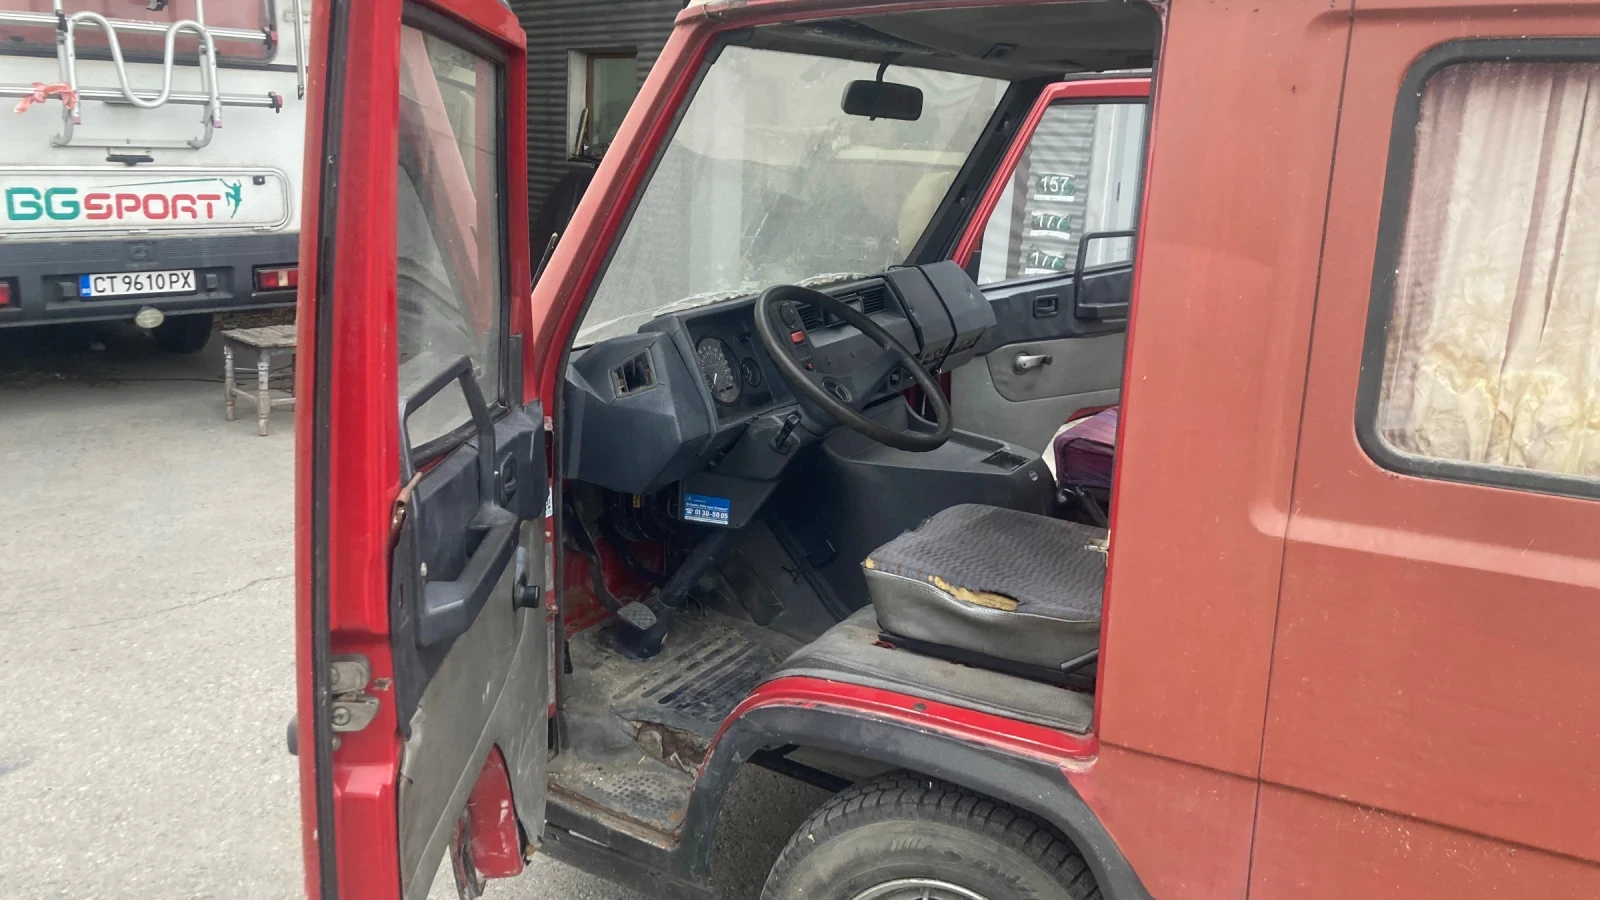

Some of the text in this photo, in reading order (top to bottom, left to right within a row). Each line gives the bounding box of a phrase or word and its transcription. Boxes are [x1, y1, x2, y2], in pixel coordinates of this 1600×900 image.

[1041, 175, 1070, 192] 157
[94, 272, 192, 293] CT 9610 PX
